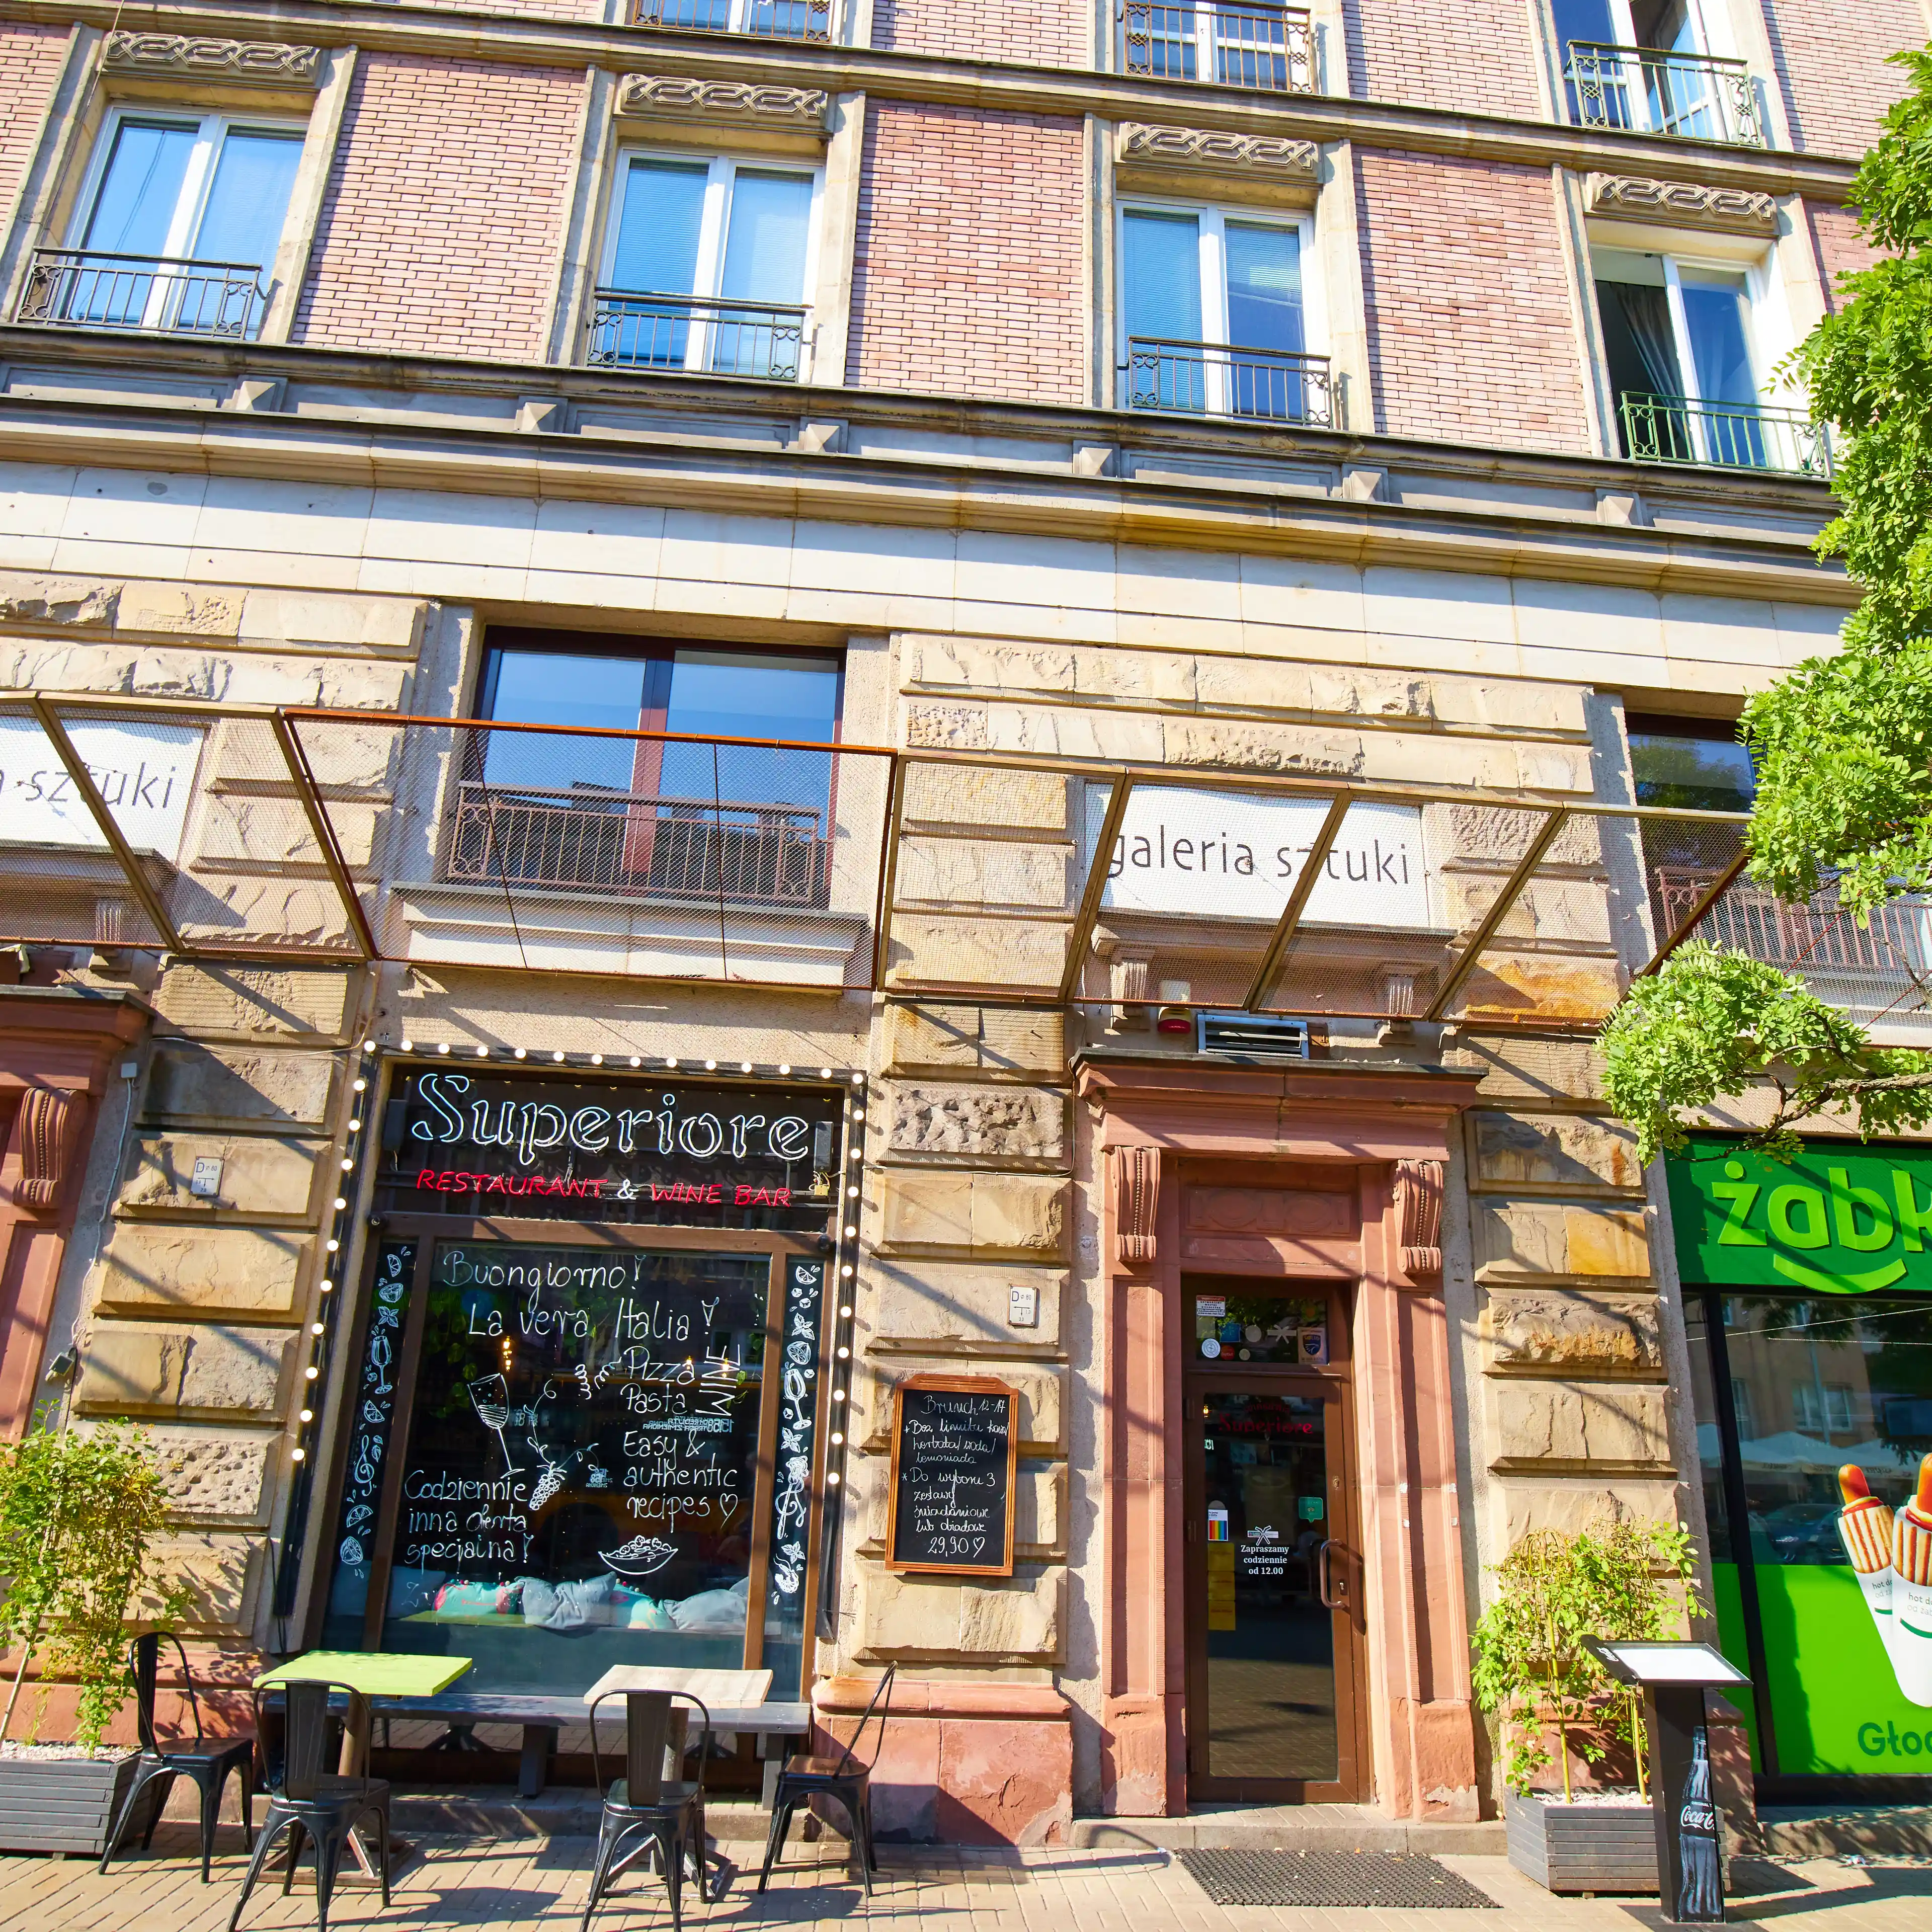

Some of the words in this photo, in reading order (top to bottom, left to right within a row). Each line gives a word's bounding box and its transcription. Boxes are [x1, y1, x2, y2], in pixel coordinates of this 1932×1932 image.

[1107, 824, 1253, 878] galeria
[412, 1072, 809, 1166] Superiore
[196, 1162, 205, 1173] D
[416, 1169, 608, 1198] RESTAURANT
[616, 1178, 636, 1200] &
[652, 1183, 723, 1205] WINE
[735, 1184, 791, 1208] BAR
[443, 1251, 647, 1313] Buongiorno!
[1012, 1291, 1019, 1301] D
[468, 1303, 502, 1336] La
[520, 1308, 589, 1337] vera
[624, 1345, 695, 1385] Pizza
[620, 1383, 688, 1415] Pasta
[979, 1398, 1006, 1413] 12-17
[909, 1420, 933, 1434] Bez
[623, 1430, 677, 1471] Easy
[685, 1429, 705, 1457] &
[623, 1453, 738, 1487] authentic
[910, 1467, 928, 1482] Do
[986, 1472, 996, 1487] 3
[405, 1470, 528, 1501] Codziennie
[409, 1508, 458, 1533] inna
[627, 1493, 710, 1534] recipes
[916, 1518, 934, 1532] lub
[928, 1536, 969, 1557] 29,90
[1241, 1545, 1289, 1554] Zapraszamy
[1872, 1581, 1885, 1589] hot
[1908, 1592, 1923, 1603] hot
